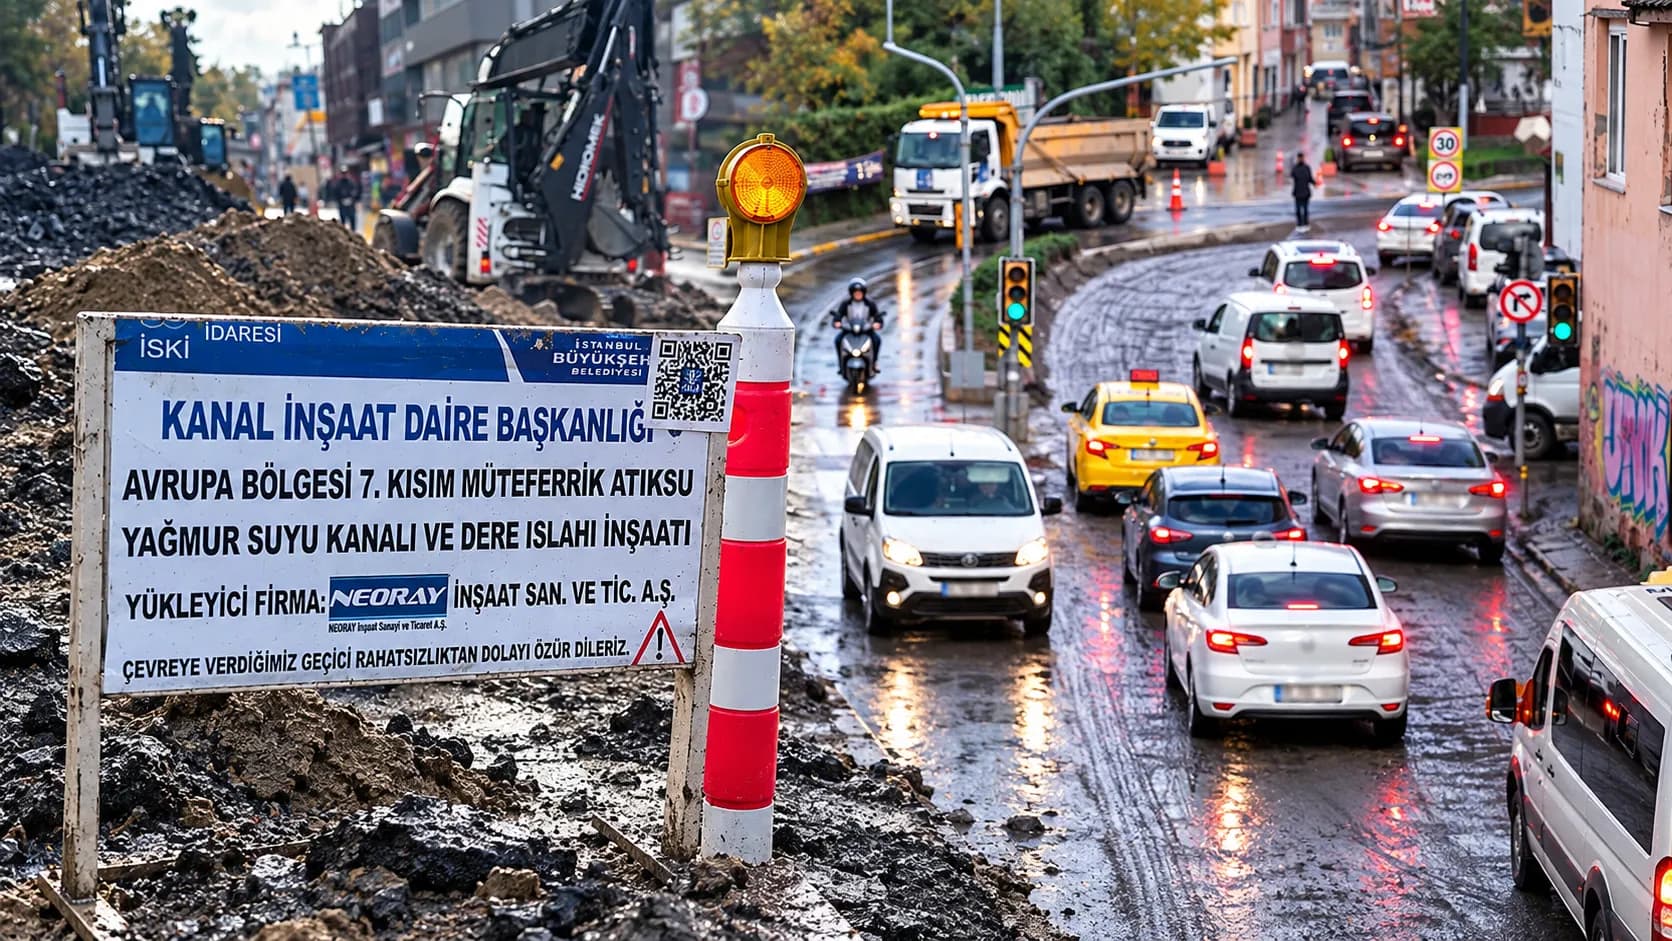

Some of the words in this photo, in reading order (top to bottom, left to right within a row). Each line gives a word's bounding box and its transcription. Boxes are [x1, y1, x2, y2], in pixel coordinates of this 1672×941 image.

[1436, 137, 1454, 150] 30
[205, 322, 281, 342] İDARESİ
[575, 339, 641, 351] İSTANBUL
[140, 333, 189, 359] İSKİ
[553, 350, 649, 367] BÜYÜKŞEH
[162, 400, 273, 440] KANAL
[284, 393, 396, 451] İNŞAAT
[404, 396, 488, 441] DAİRE
[123, 469, 233, 500] AVRUPA
[242, 462, 351, 500] BÖLGESİ
[360, 470, 380, 499] 7.
[388, 469, 454, 498] KISIM
[462, 461, 604, 498] MÜTEFERRİK
[611, 469, 693, 497] ATIKSU
[122, 519, 239, 557] YAĞMUR
[248, 525, 318, 554] SUYU
[326, 523, 416, 553] KANALI
[424, 523, 454, 551] VE
[461, 521, 519, 550] DERE
[526, 520, 596, 549] ISLAHI
[604, 513, 691, 553] İNŞAATI
[126, 584, 248, 620] YÜKLEYİCİ
[255, 583, 326, 615] FİRMA:
[330, 586, 447, 607] NEORAY
[454, 578, 521, 614] İNŞAAT
[526, 583, 567, 605] SAN.
[572, 581, 596, 604] VE
[601, 575, 636, 603] TİC.
[642, 579, 676, 608] A.Ş.
[328, 623, 356, 633] NEORAY
[378, 620, 401, 632] Sanayi
[402, 622, 409, 631] ve
[410, 620, 433, 631] Ticaret
[434, 619, 447, 631] A.Ş.
[122, 658, 200, 685] ÇEVREYE
[205, 648, 297, 675] VERDİĞİMİZ
[301, 647, 351, 676] GEÇİCİ
[355, 643, 477, 669] RAHATSIZLIKTAN
[481, 643, 532, 663] DOLAYI
[534, 637, 571, 660] ÖZÜR
[574, 636, 630, 658] DİLERİZ.
